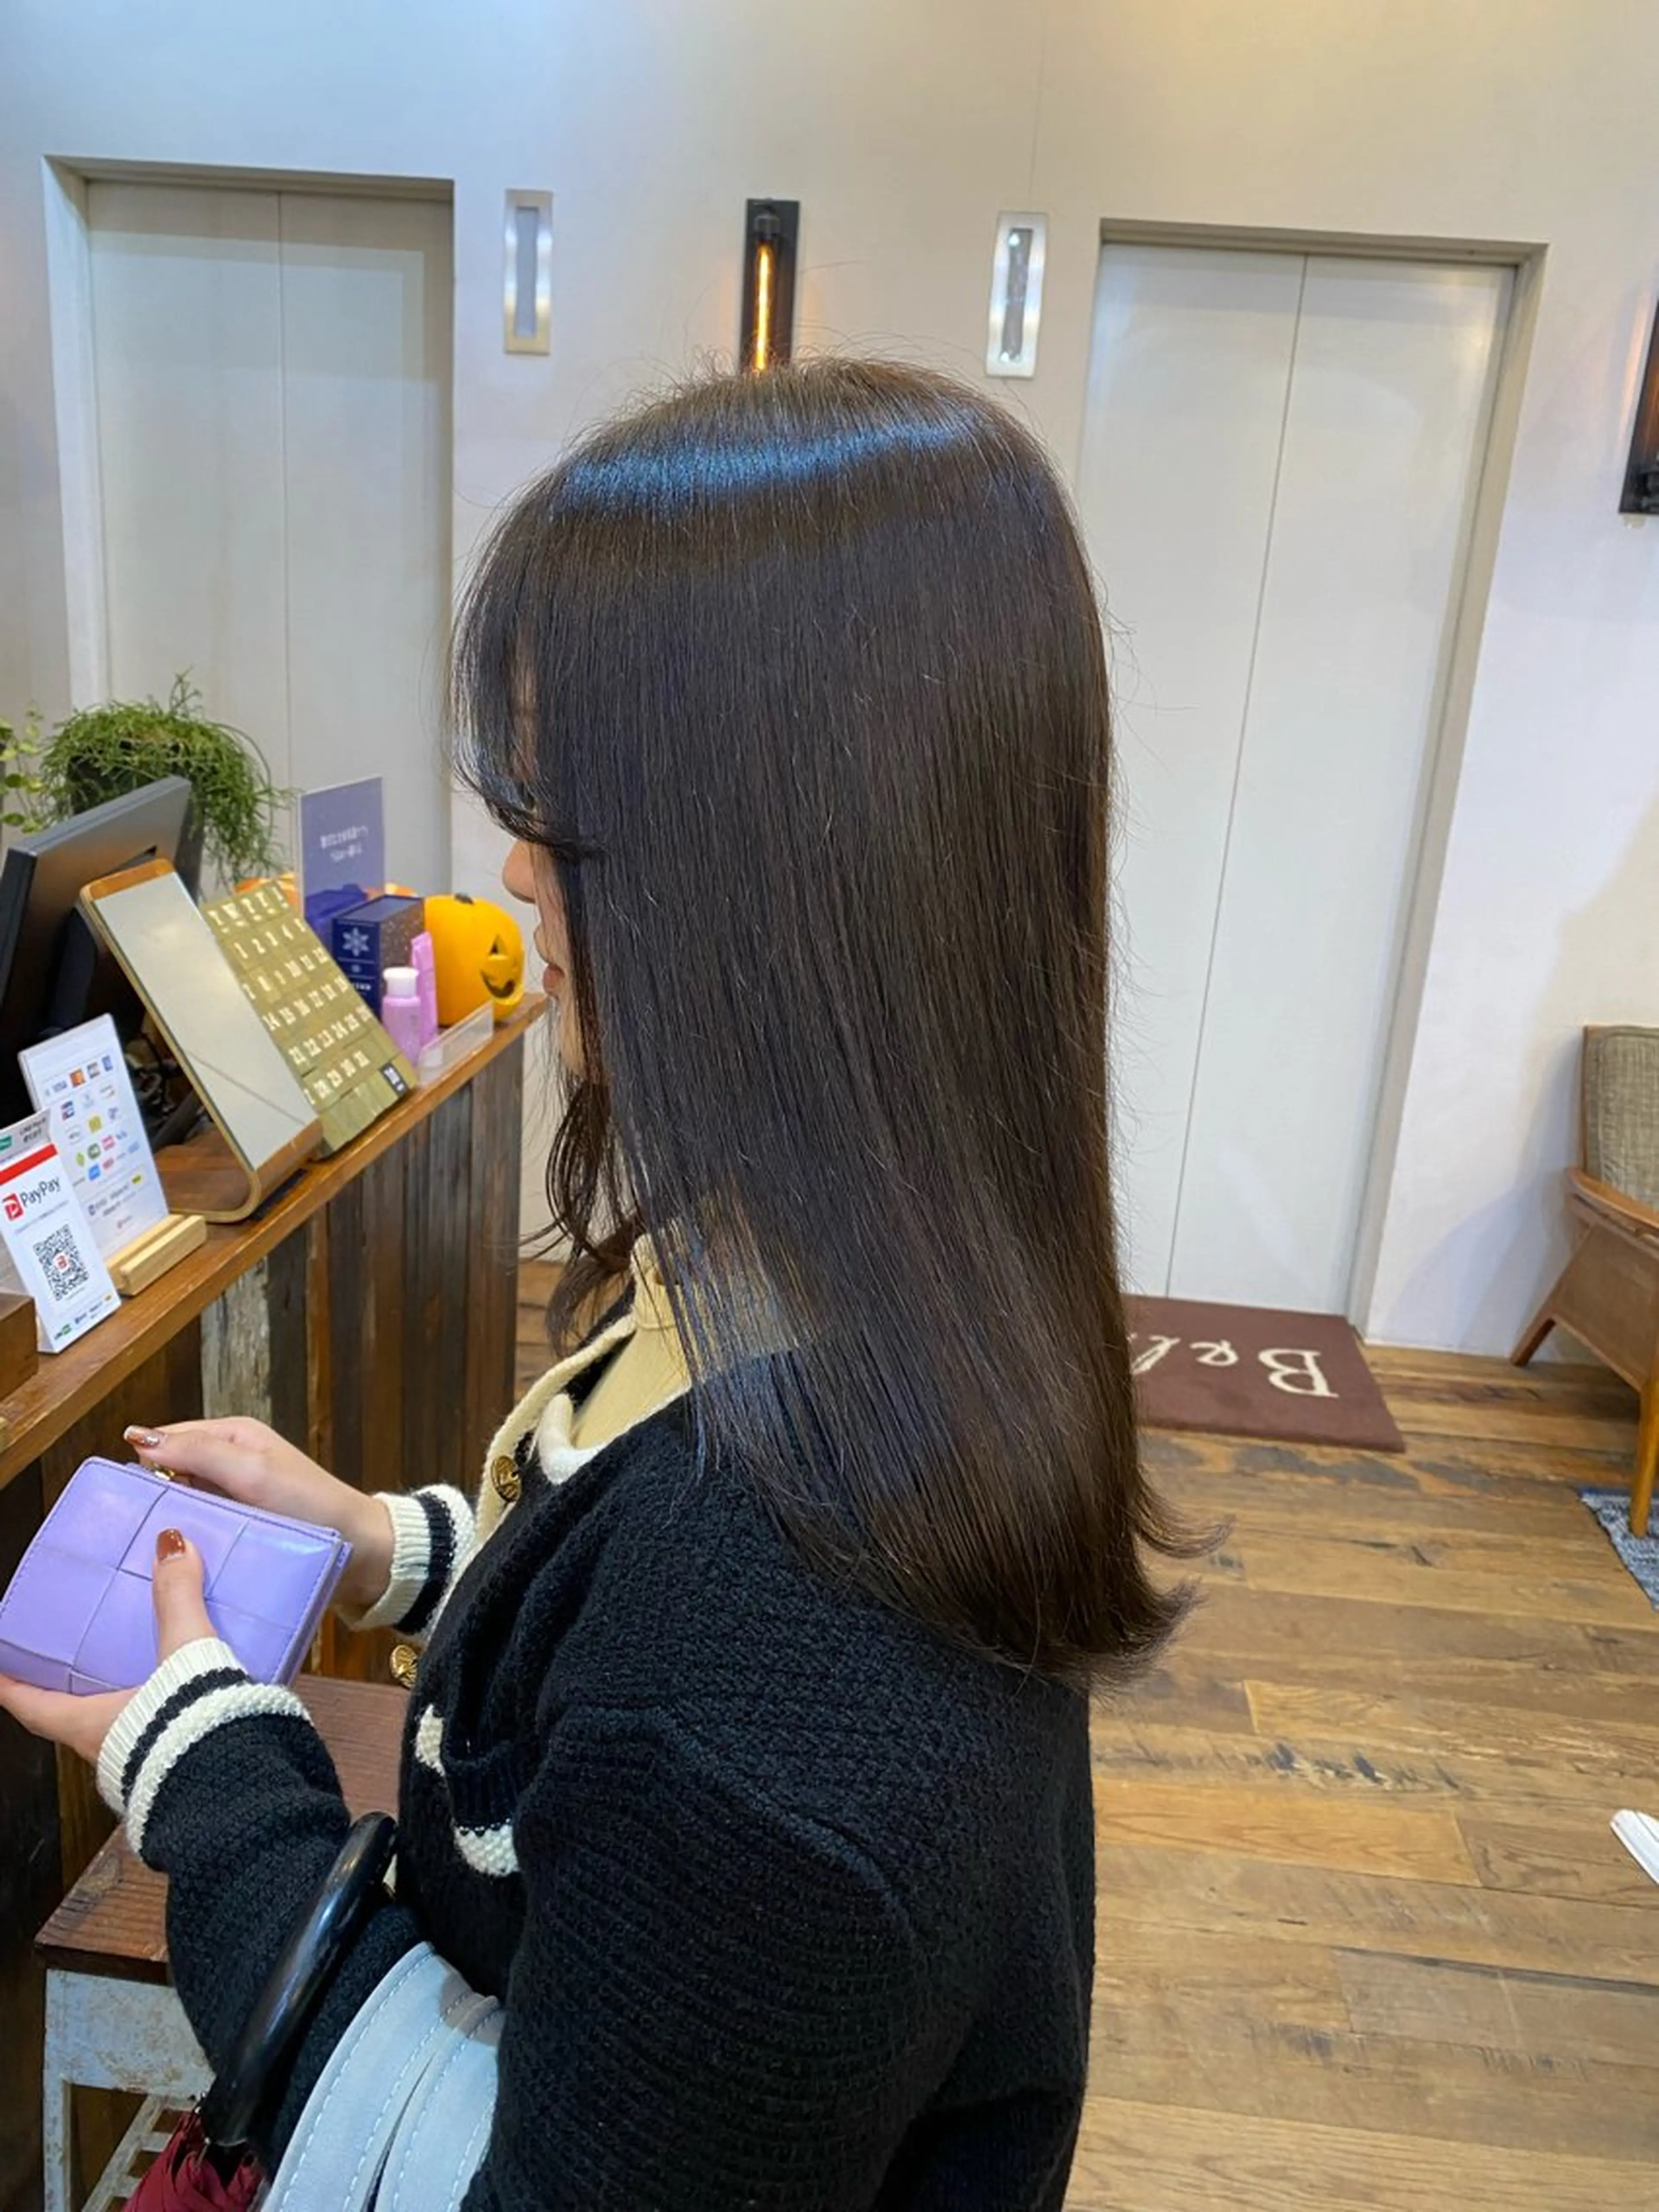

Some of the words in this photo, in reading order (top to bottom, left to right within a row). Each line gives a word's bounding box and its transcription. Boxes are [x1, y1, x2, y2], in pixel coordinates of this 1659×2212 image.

[262, 1013, 280, 1031] 14
[280, 1007, 296, 1024] 15
[289, 1047, 306, 1065] 21
[303, 1039, 322, 1056] 22
[331, 1021, 347, 1038] 24
[20, 1177, 60, 1208] PayPay
[1127, 1333, 1339, 1398] Bel
